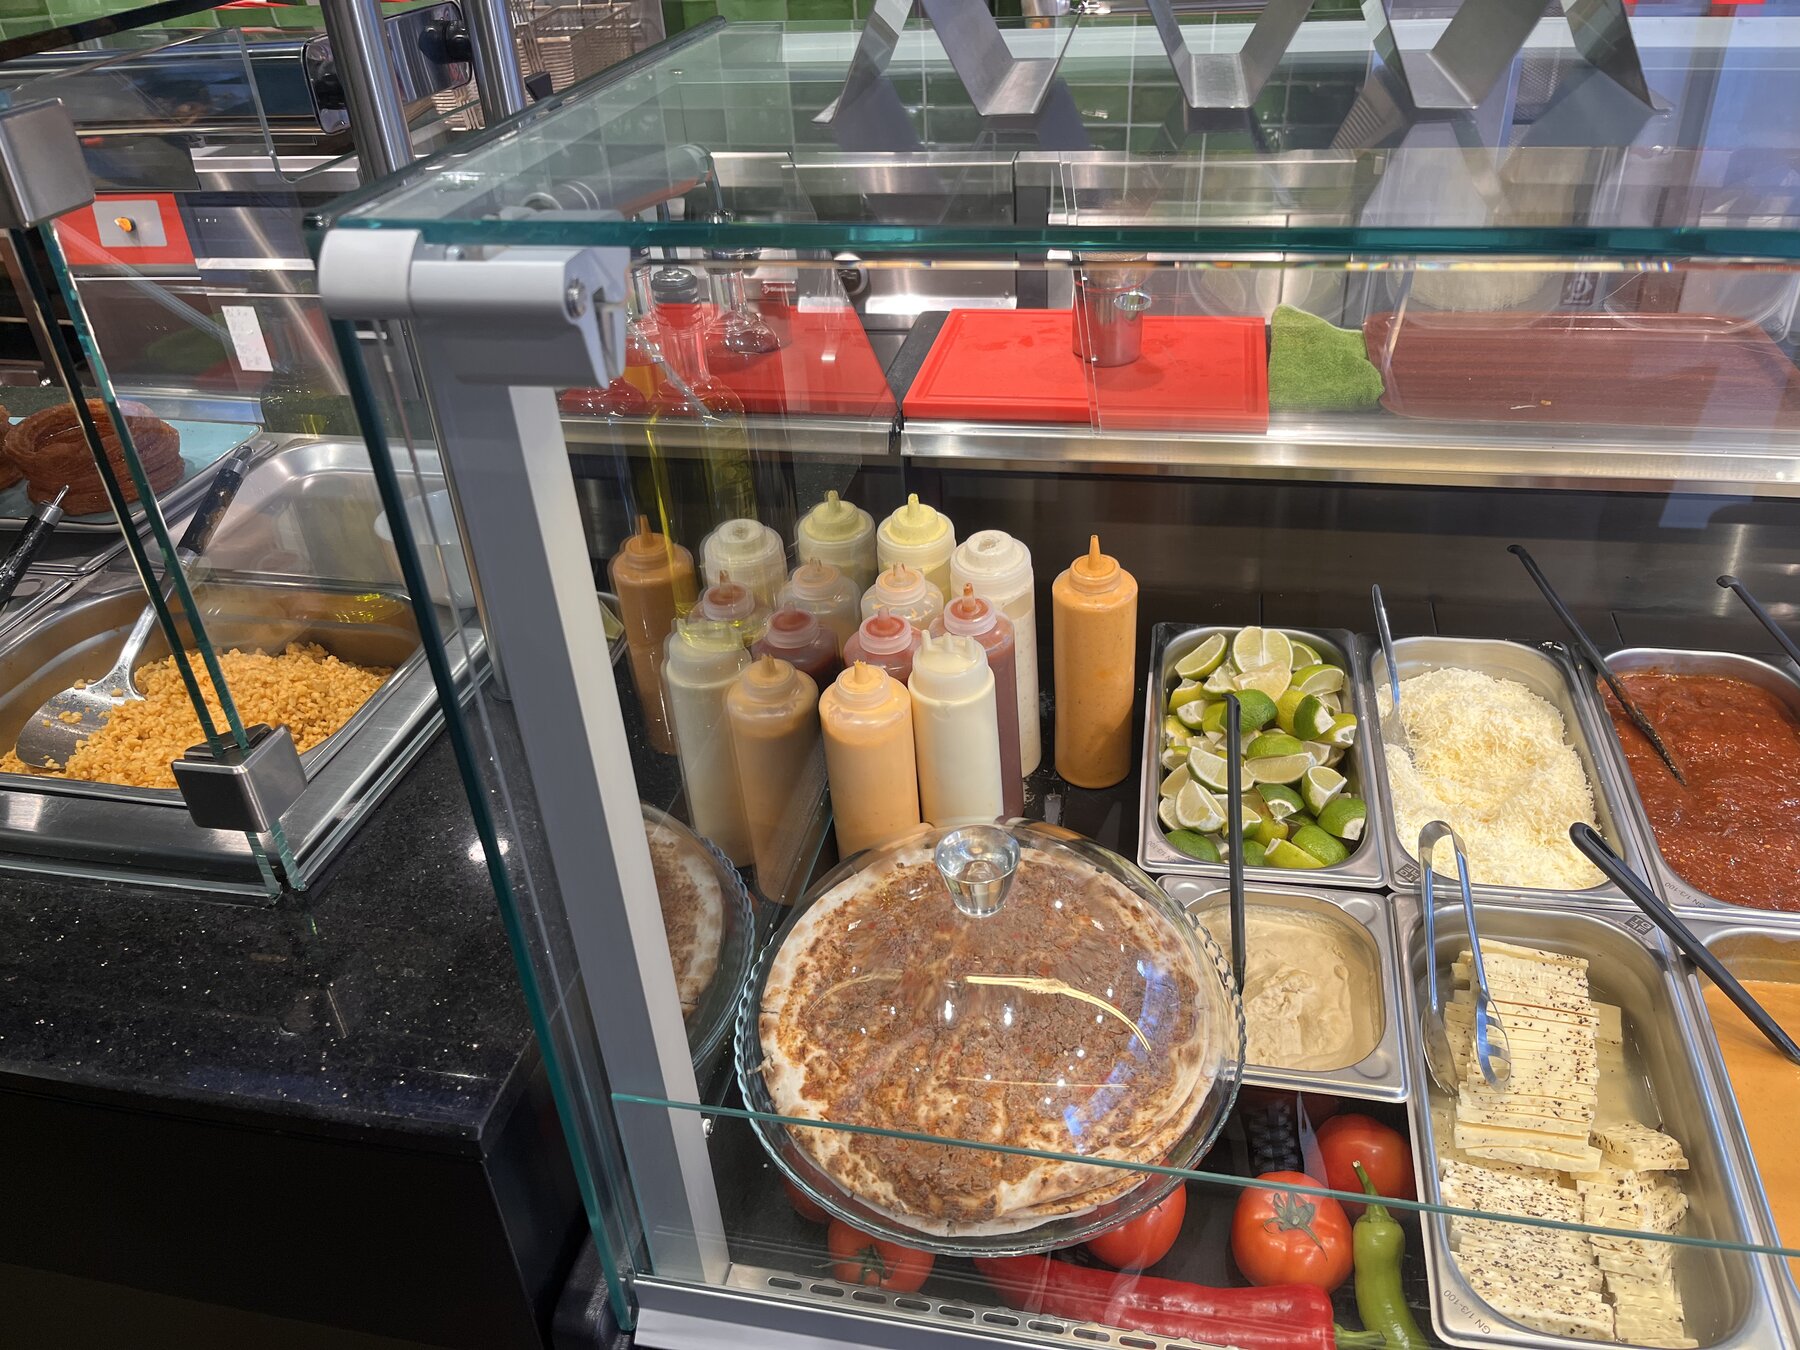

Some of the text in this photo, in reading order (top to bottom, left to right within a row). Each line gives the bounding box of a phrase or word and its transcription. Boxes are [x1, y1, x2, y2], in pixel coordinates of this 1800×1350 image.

[1692, 899, 1706, 909] GN
[1443, 1289, 1491, 1335] GN 1/3-100
